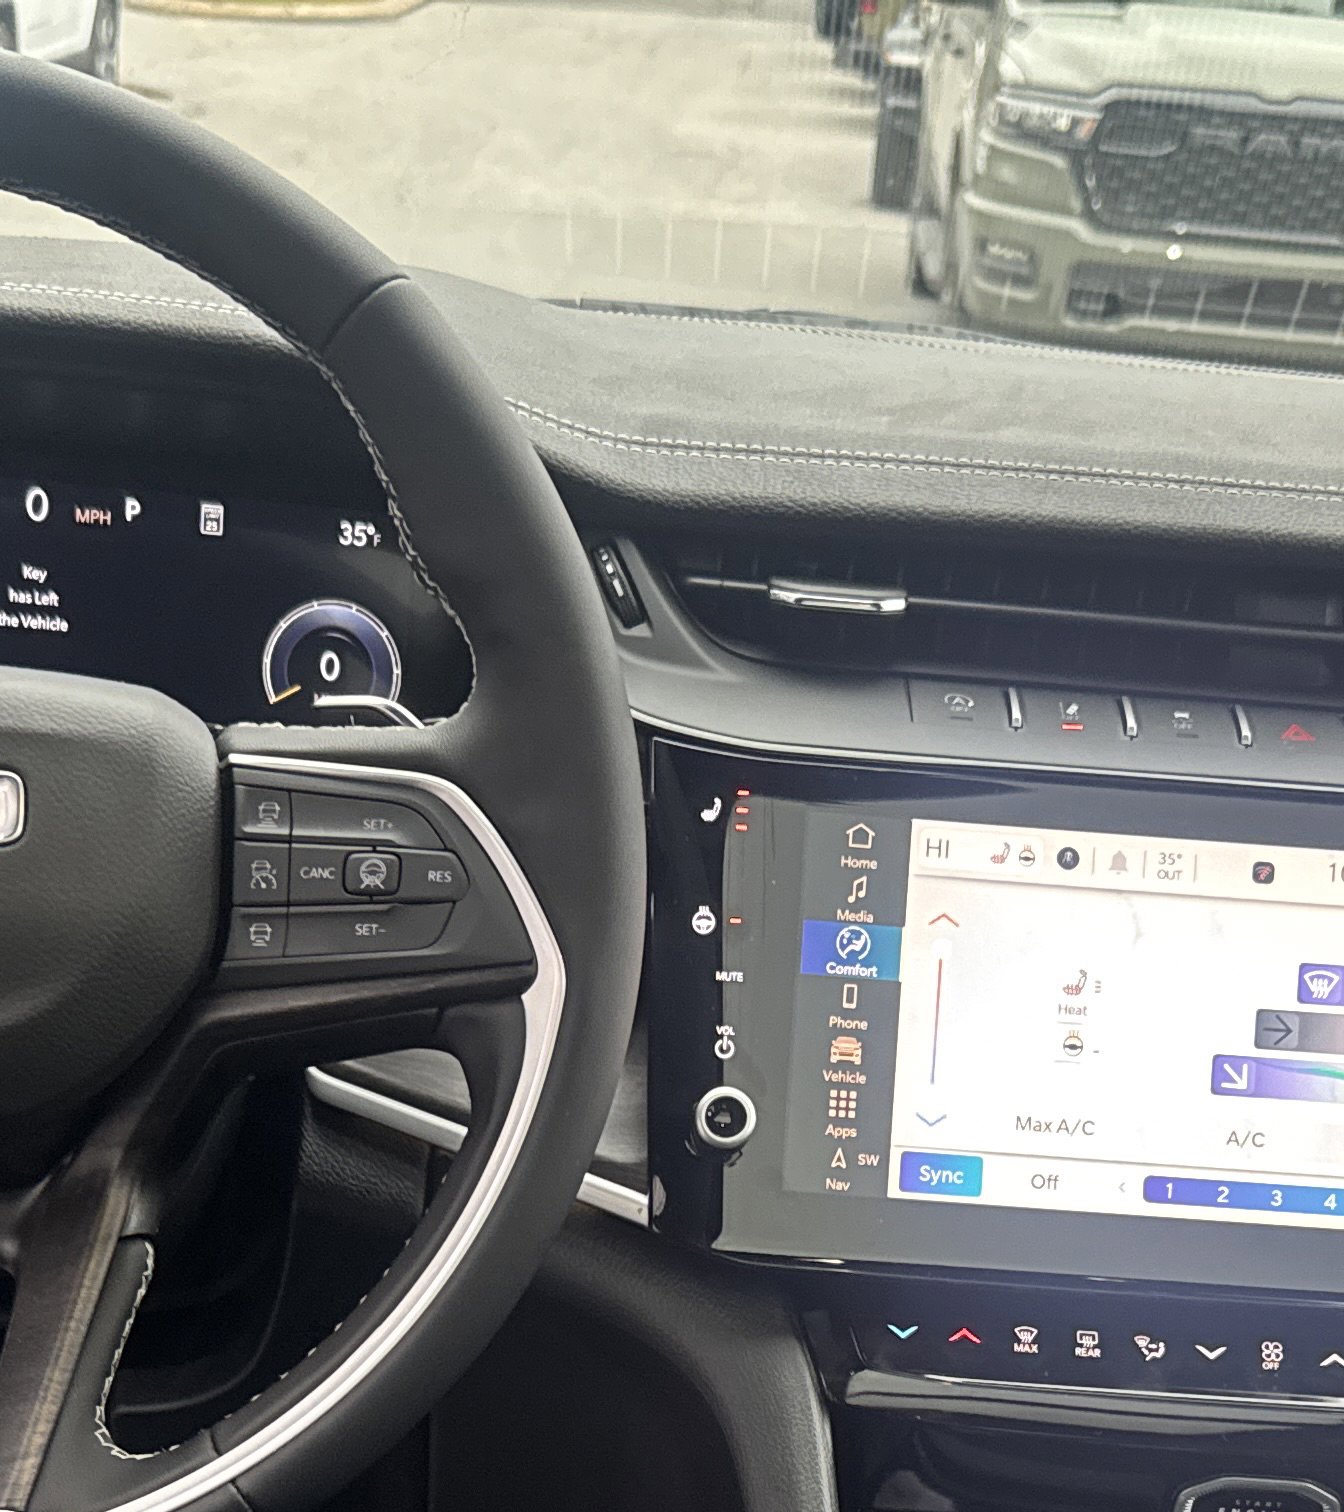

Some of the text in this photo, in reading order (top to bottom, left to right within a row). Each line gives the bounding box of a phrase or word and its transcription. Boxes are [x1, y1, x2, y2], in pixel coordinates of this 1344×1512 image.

[25, 486, 111, 526] 0 MPH
[125, 496, 141, 522] P
[21, 564, 48, 584] Key
[8, 587, 60, 607] has Left
[21, 613, 69, 632] Vehicle
[320, 651, 341, 682] 0
[925, 838, 950, 859] HI
[840, 855, 878, 870] Home
[299, 867, 337, 880] CANC
[427, 871, 452, 883] RES
[1157, 869, 1183, 881] OUT
[836, 908, 874, 924] Media
[715, 970, 744, 983] MUTE
[825, 961, 878, 978] Comfort
[1058, 1003, 1087, 1017] Heat
[716, 1025, 735, 1036] VOL
[828, 1015, 868, 1031] Phone
[822, 1069, 867, 1085] Vehicle
[825, 1124, 858, 1140] Apps
[1015, 1115, 1096, 1137] Max A/C
[1226, 1130, 1265, 1149] A/C
[857, 1153, 880, 1167] SW
[919, 1165, 964, 1186] Sync
[1031, 1174, 1059, 1191] Off
[825, 1178, 851, 1192] Nav
[1166, 1182, 1173, 1200] 1
[1217, 1186, 1229, 1203] 2
[1270, 1189, 1283, 1207] 3
[1323, 1193, 1337, 1211] 4
[1014, 1343, 1038, 1354] MAX
[1075, 1347, 1101, 1358] REAR
[1262, 1361, 1280, 1371] OFF
